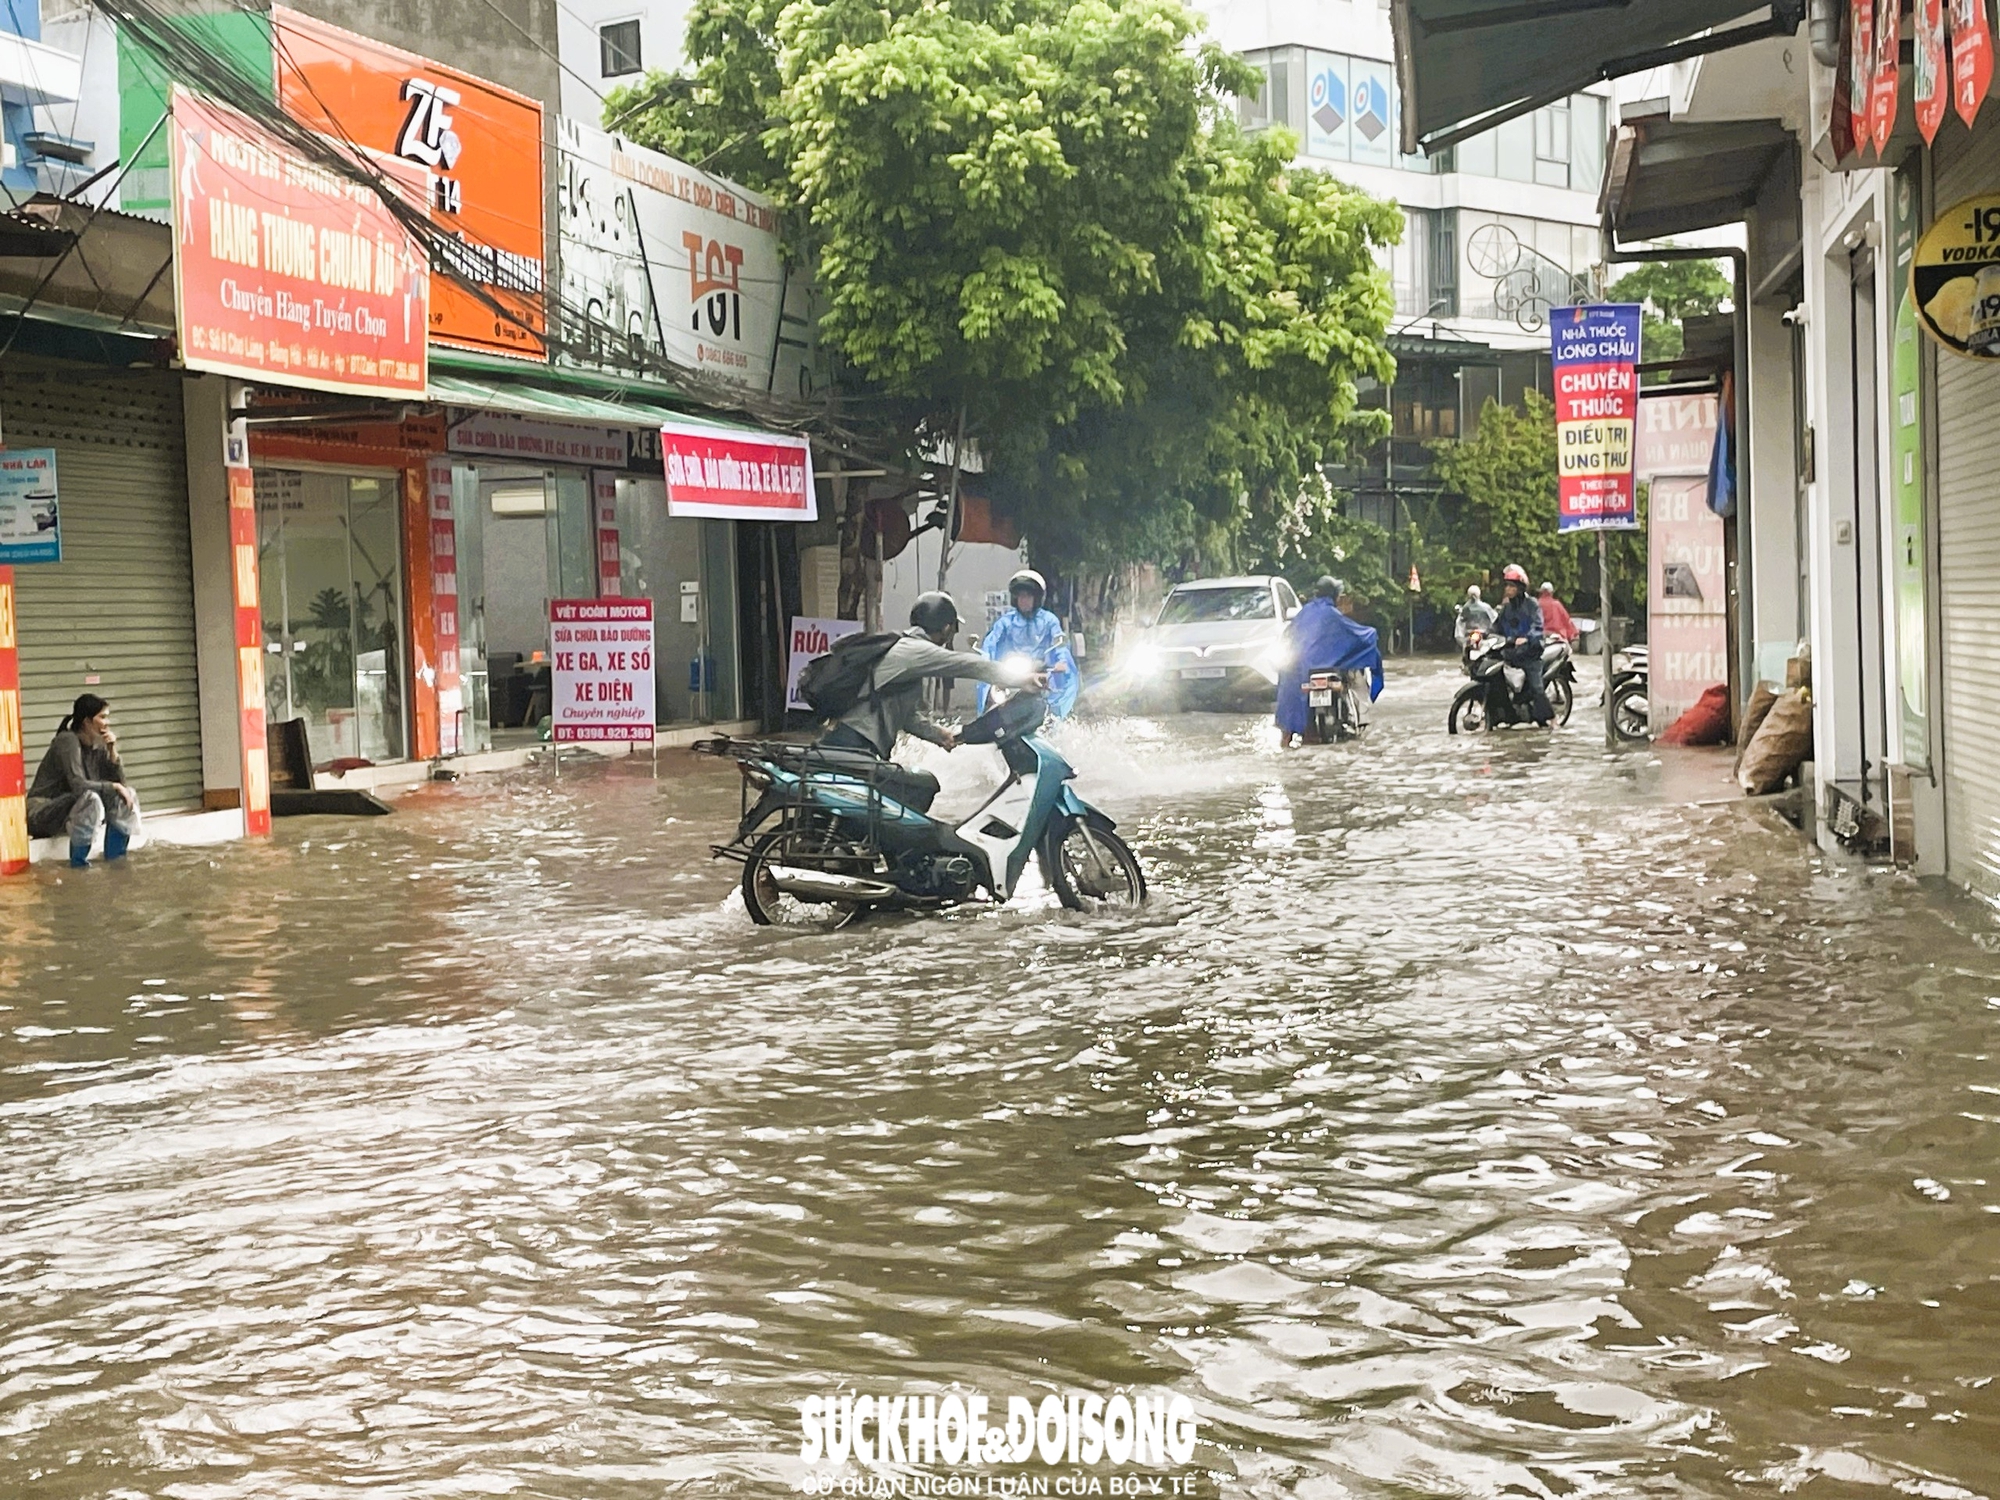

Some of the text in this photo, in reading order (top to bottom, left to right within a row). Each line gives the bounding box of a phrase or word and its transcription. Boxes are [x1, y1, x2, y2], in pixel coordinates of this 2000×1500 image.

[638, 160, 674, 195] DOANH
[678, 175, 690, 201] XE
[209, 187, 259, 268] HÀNG
[261, 205, 315, 281] THÙNG
[374, 231, 395, 297] ÂU
[220, 278, 273, 321] Chuyên
[276, 290, 311, 332] Hàng
[355, 305, 387, 343] Chọn
[1562, 321, 1627, 340] NHÀ THUỐC
[1557, 338, 1635, 360] LONG CHÂU
[1561, 369, 1630, 394] CHUYÊN
[1568, 391, 1623, 418] THUỐC
[1607, 426, 1627, 448] TRỊ
[1564, 450, 1628, 470] UNG THƯ
[1569, 492, 1603, 513] BỆNH
[609, 606, 647, 618] MOTOR
[554, 626, 572, 643] SỬA
[574, 627, 598, 642] CHỮA
[600, 625, 619, 642] BẢO
[793, 623, 829, 654] RỬA
[556, 644, 651, 673] XE GA, XE SỐ
[575, 682, 594, 701] XE
[562, 706, 645, 720] Chuyên nghiệp
